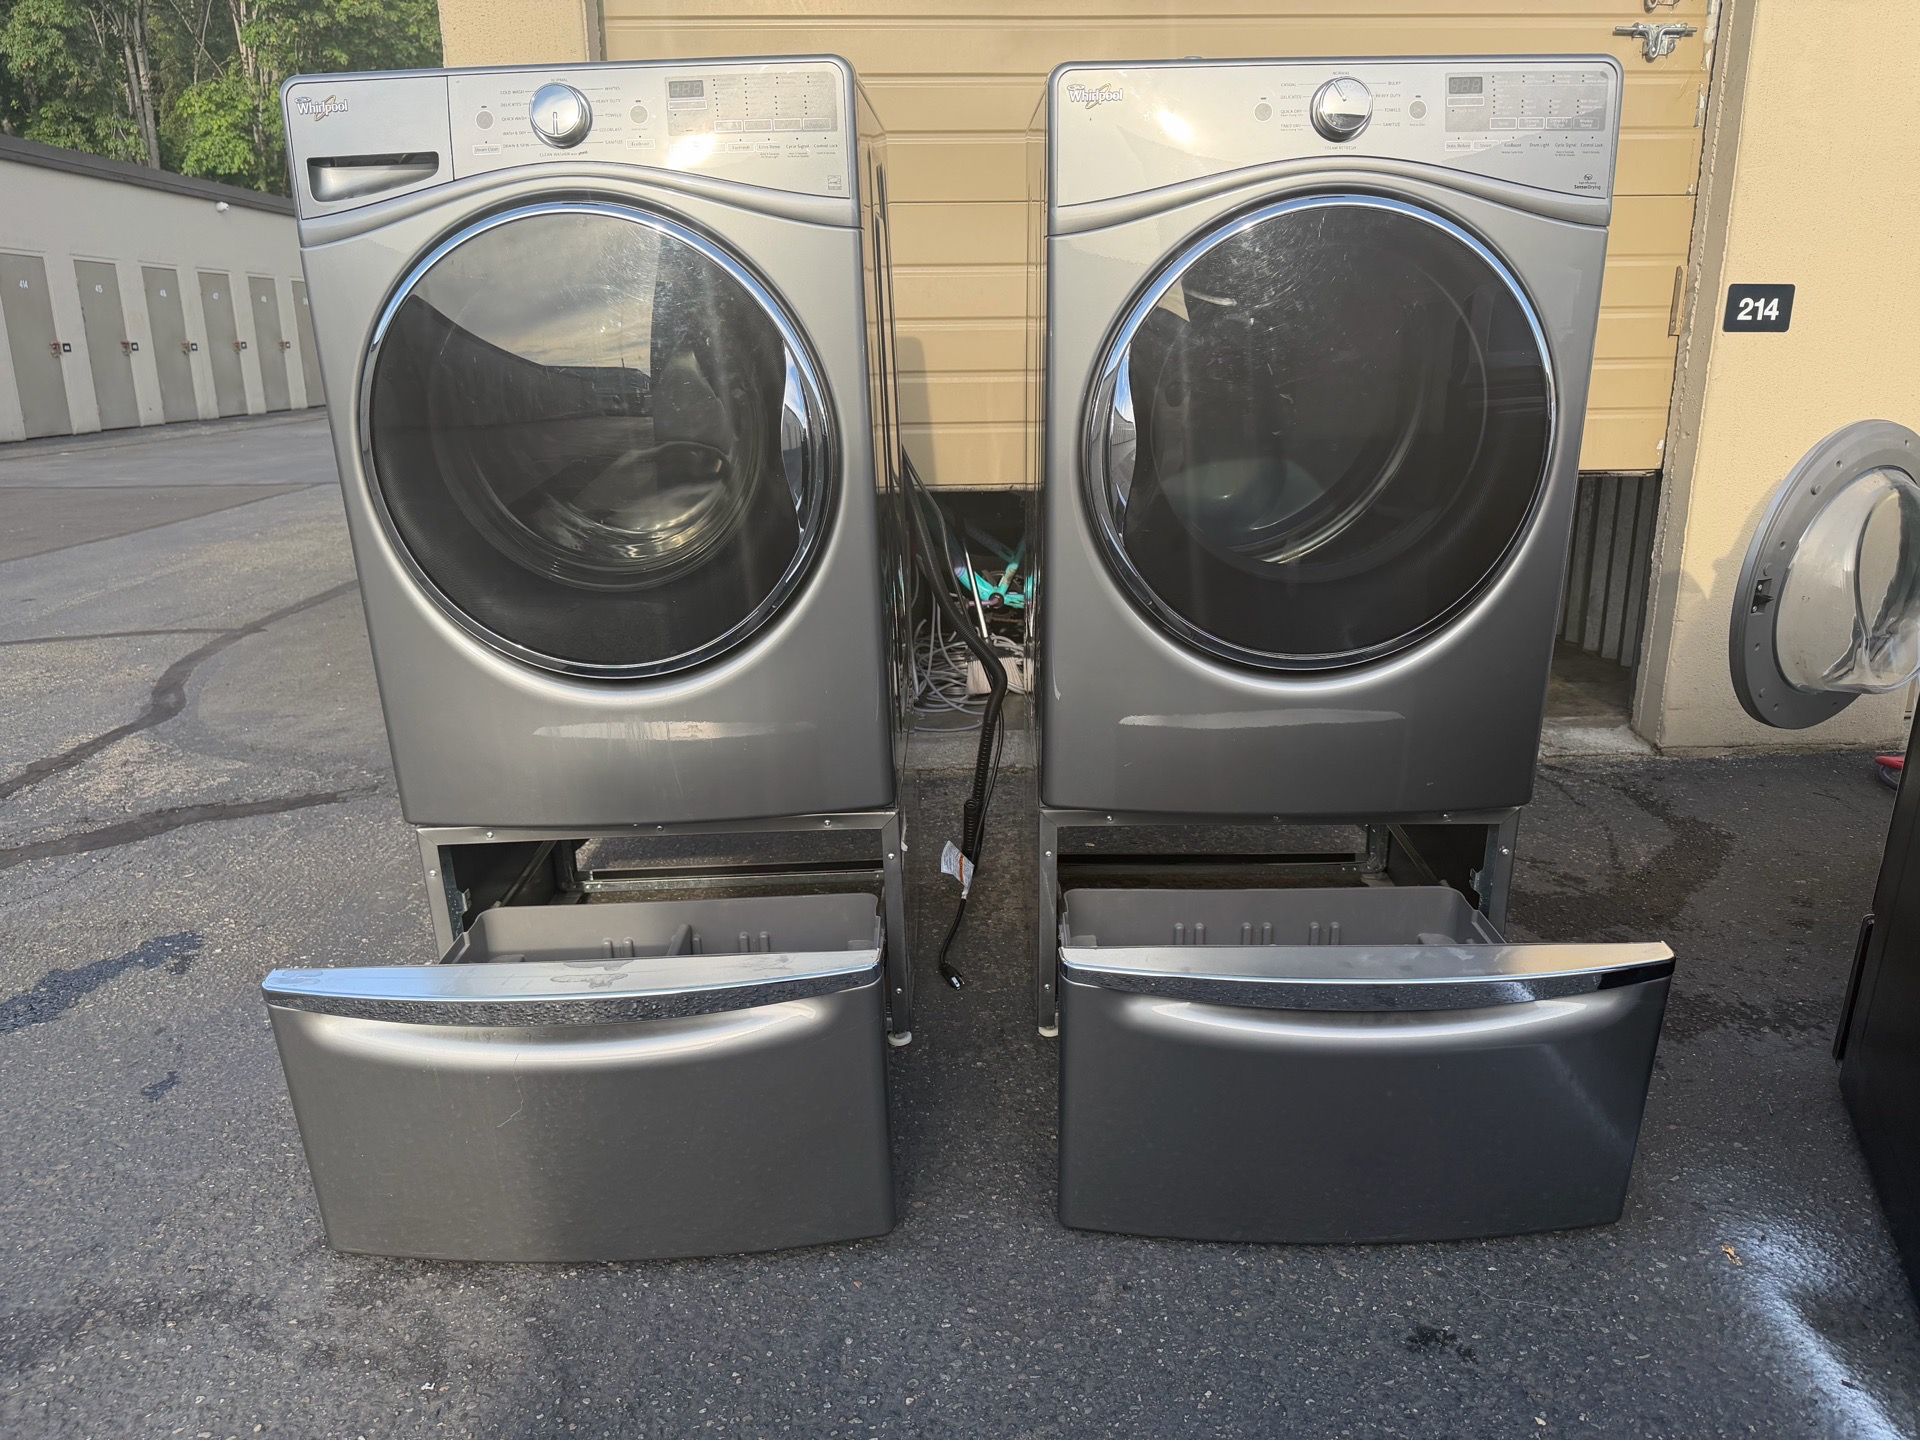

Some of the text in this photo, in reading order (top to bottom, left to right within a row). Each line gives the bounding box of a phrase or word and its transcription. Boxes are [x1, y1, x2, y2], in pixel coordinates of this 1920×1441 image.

[1069, 87, 1123, 105] Whirlpool
[297, 98, 348, 116] Whirlpool
[1737, 297, 1780, 321] 214
